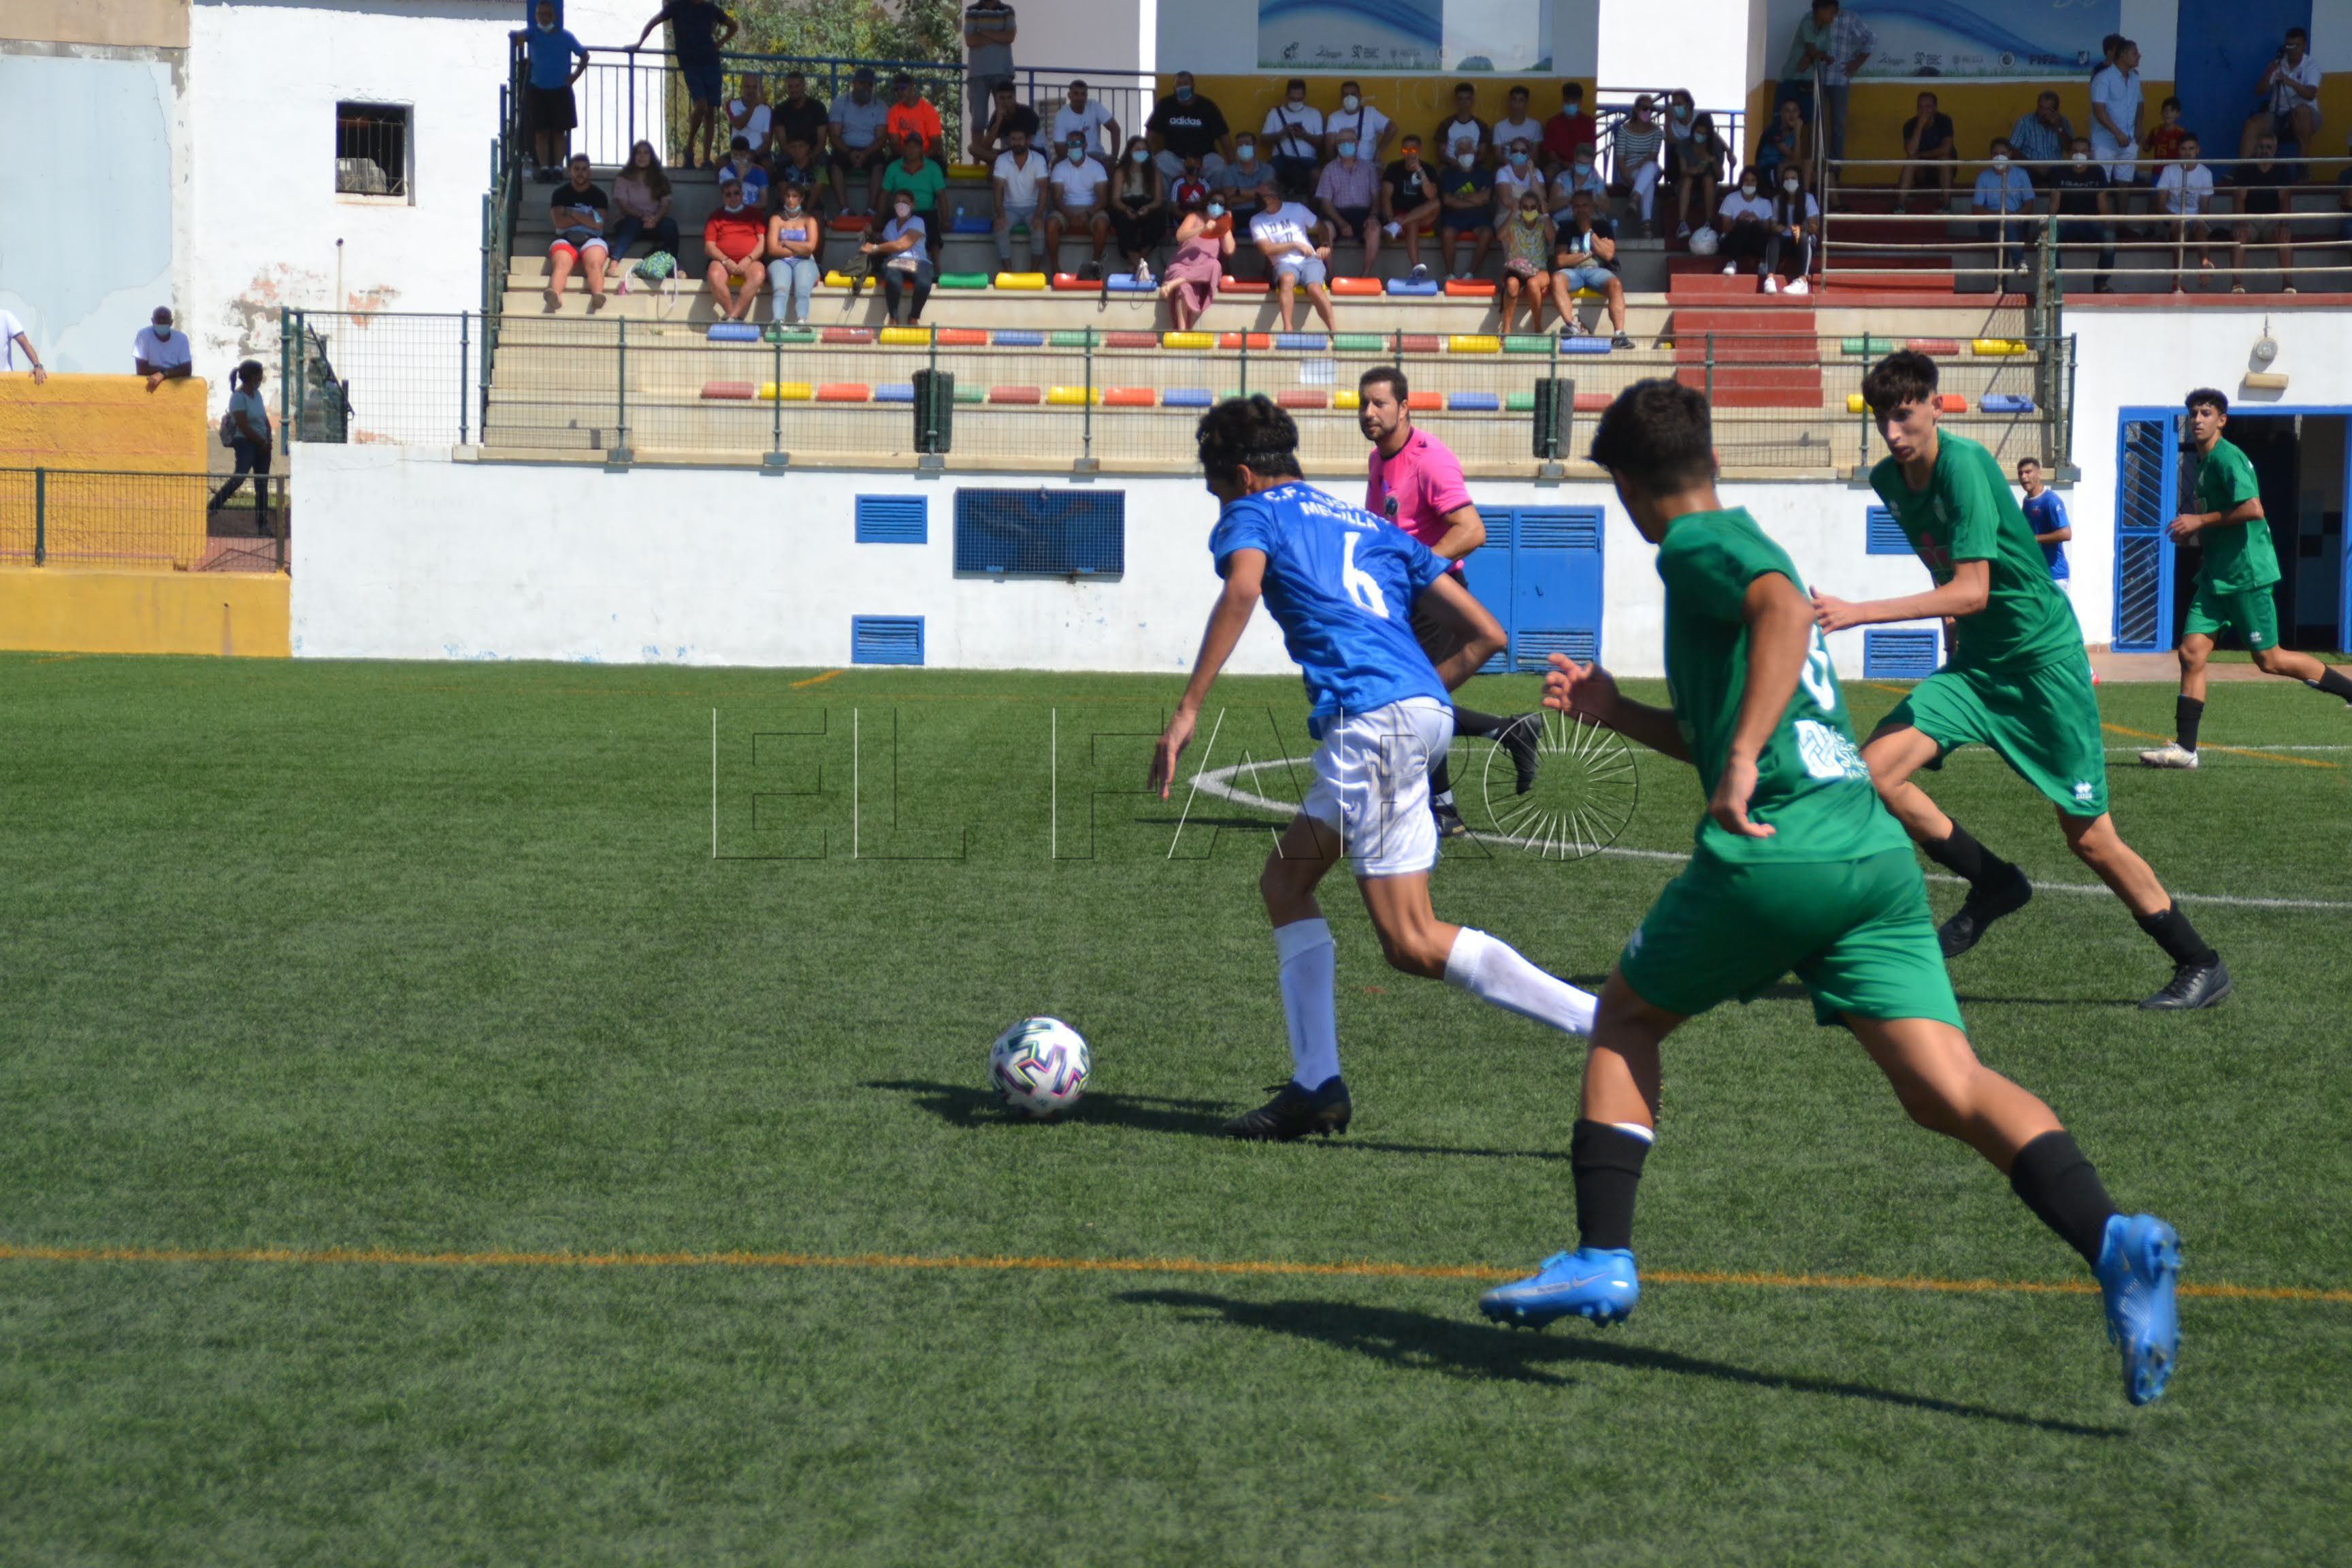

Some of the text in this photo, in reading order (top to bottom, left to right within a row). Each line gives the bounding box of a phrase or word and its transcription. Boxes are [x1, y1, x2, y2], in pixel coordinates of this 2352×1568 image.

[1170, 116, 1202, 126] adidas
[1263, 486, 1306, 501] C.F.
[1299, 501, 1380, 532] MELILLA
[1343, 532, 1390, 618] 6
